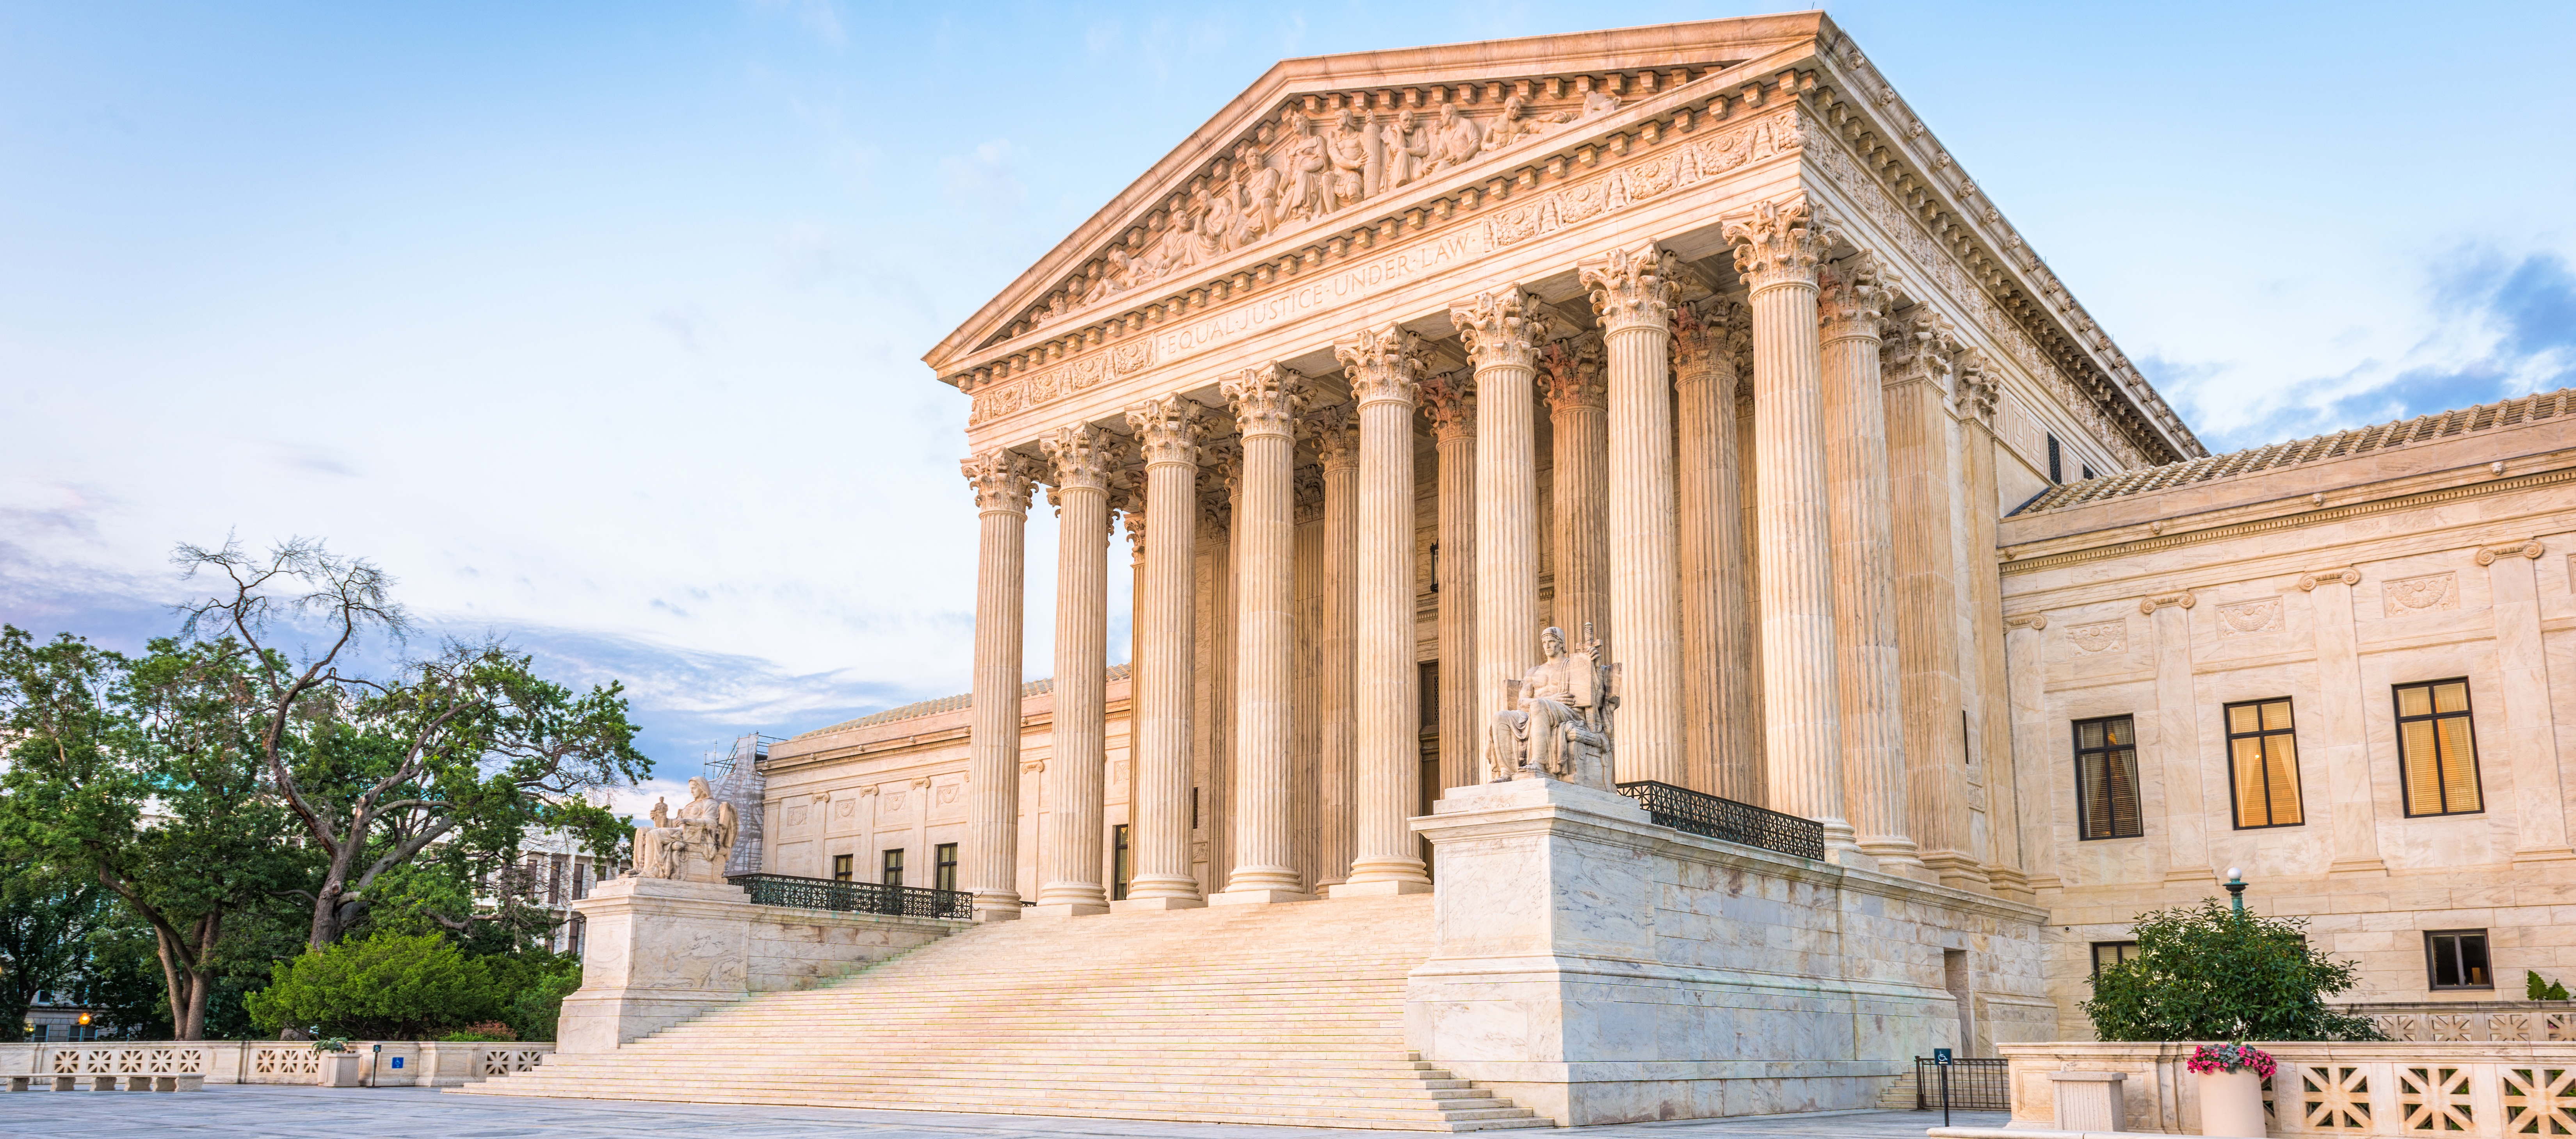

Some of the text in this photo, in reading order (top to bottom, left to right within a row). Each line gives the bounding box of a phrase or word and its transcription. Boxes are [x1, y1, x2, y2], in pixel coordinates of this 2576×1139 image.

[1168, 233, 1470, 355] EQUAL JUSTICE UNDER LAW
